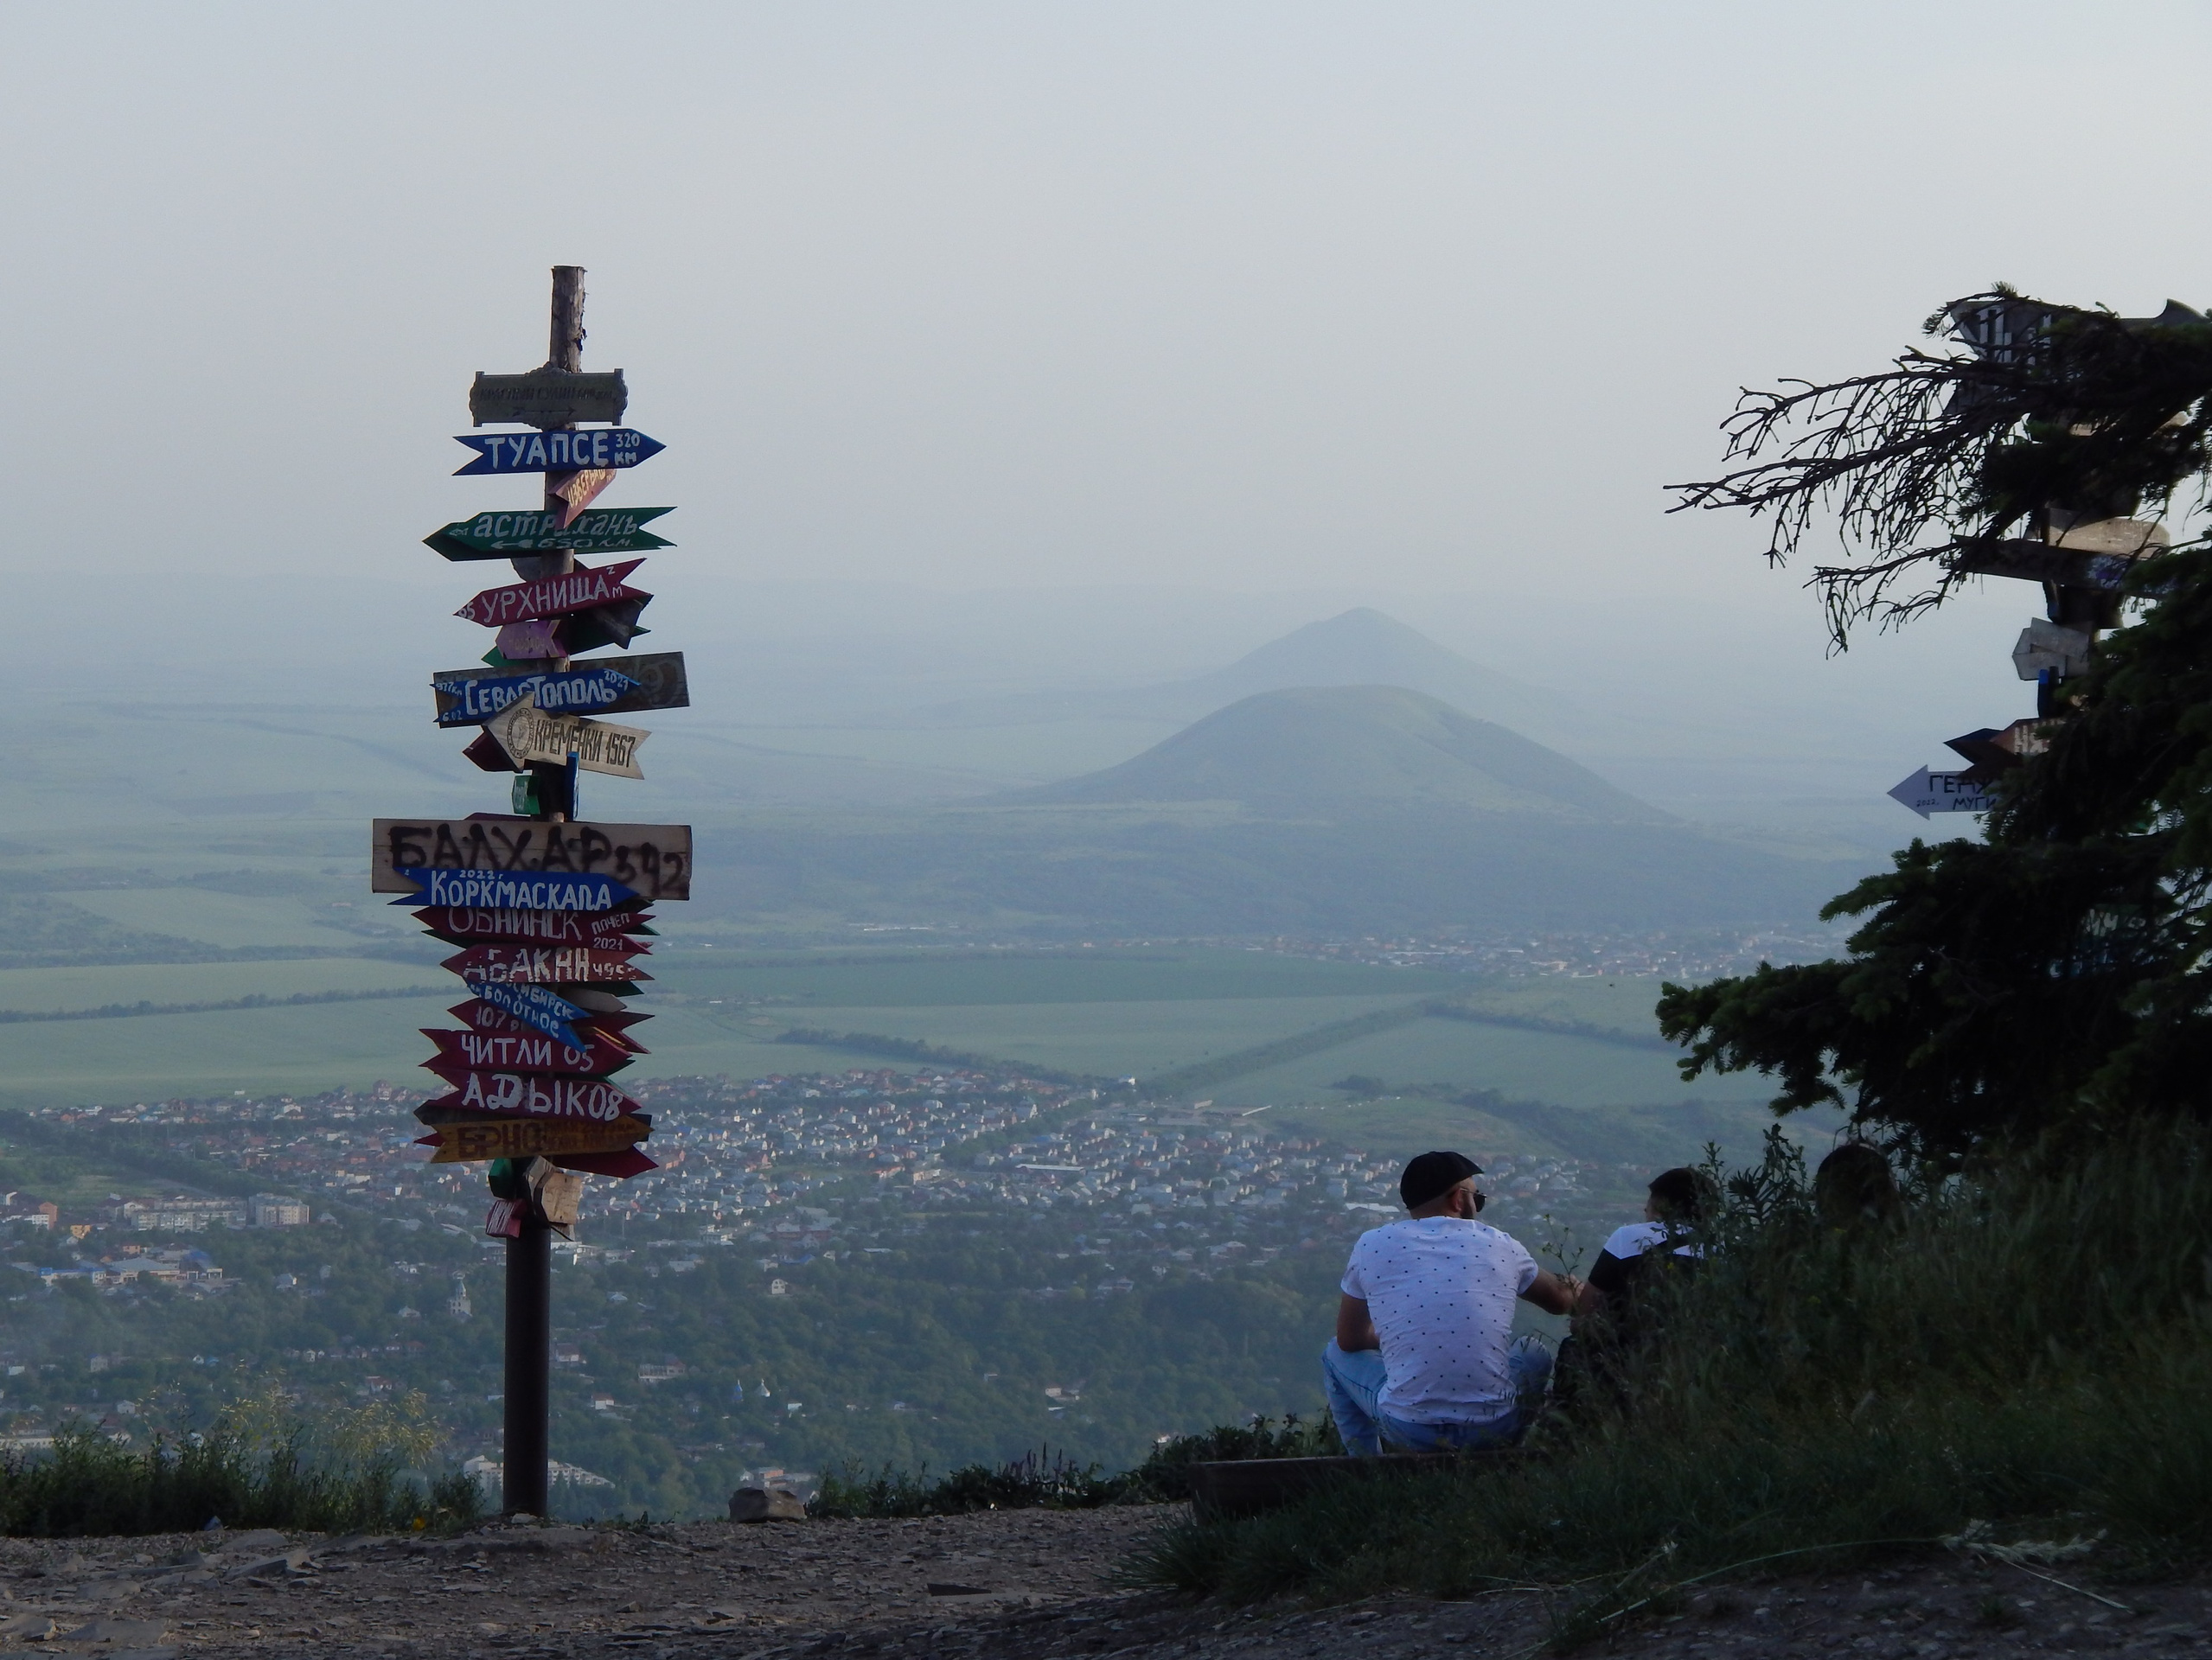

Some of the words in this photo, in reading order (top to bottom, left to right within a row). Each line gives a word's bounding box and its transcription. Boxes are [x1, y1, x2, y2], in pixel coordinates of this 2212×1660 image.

[484, 432, 609, 469] ТУАПСЕ
[615, 433, 641, 448] 320
[538, 538, 593, 550] 650
[458, 601, 476, 620] 05
[604, 669, 629, 691] 2021
[605, 732, 636, 768] 1567
[449, 908, 582, 941] ОБНИНСК
[591, 913, 630, 935] ПОЧЕП
[594, 936, 623, 951] 2021
[476, 1006, 508, 1029] 107
[461, 1033, 552, 1066] ЧИТЛИ
[564, 1044, 595, 1071] 05
